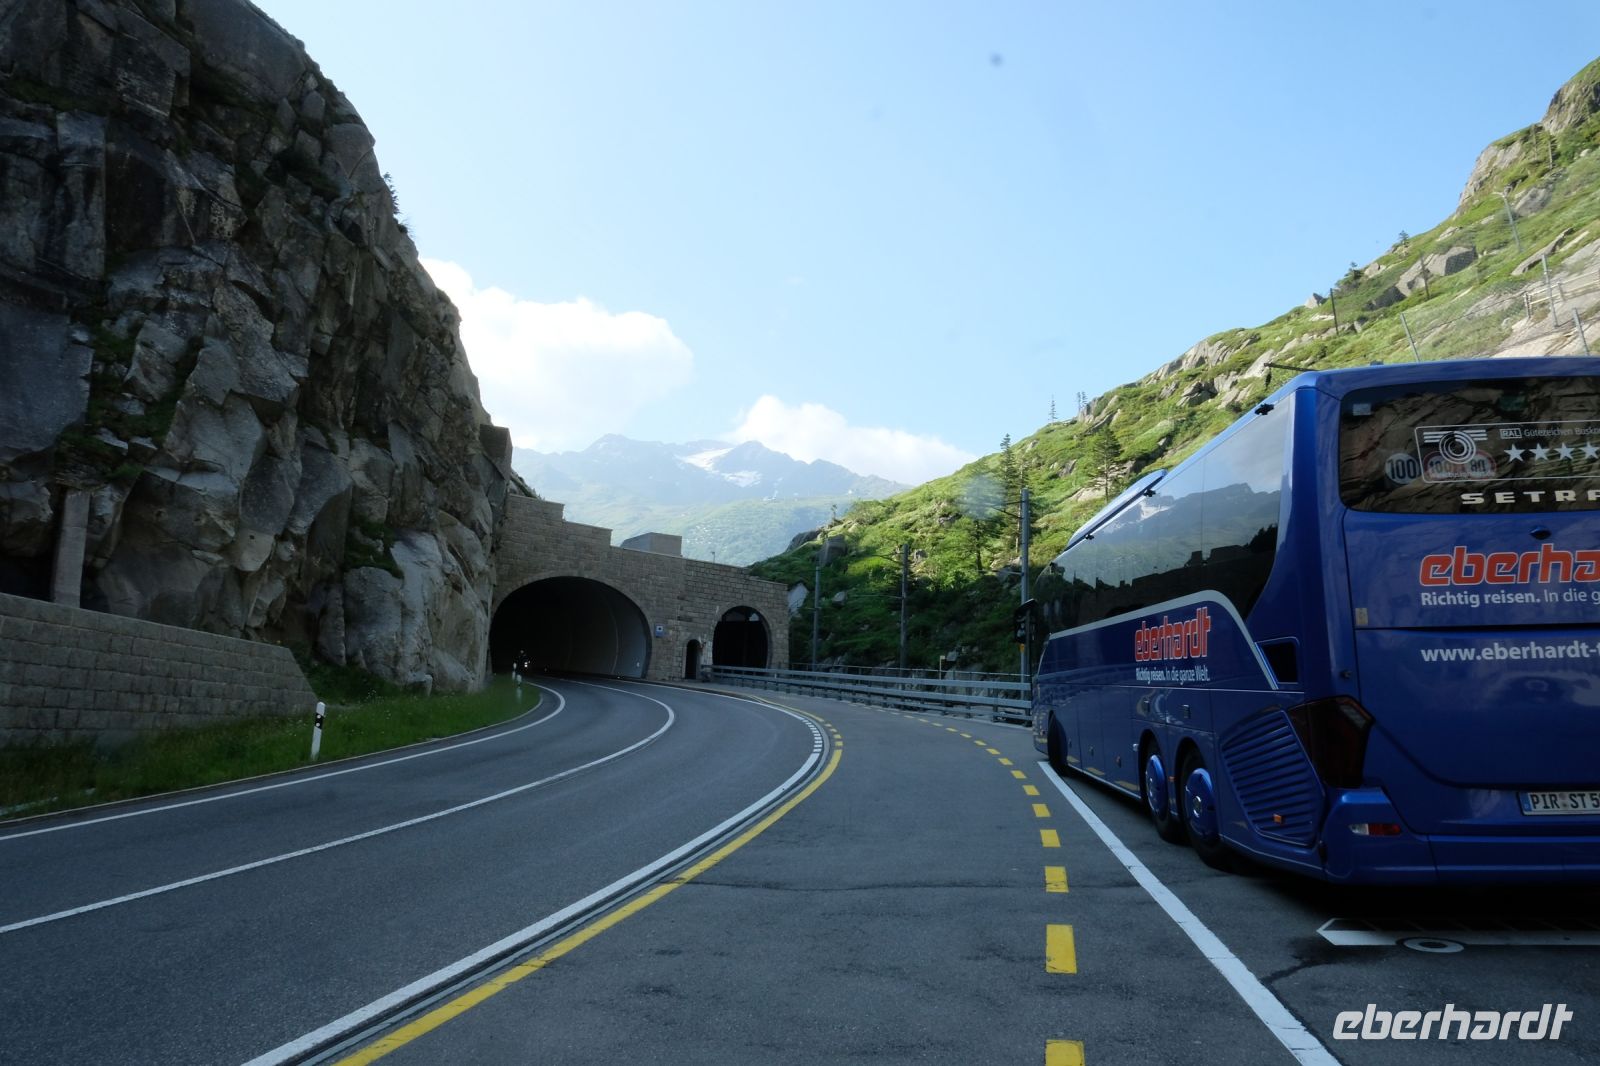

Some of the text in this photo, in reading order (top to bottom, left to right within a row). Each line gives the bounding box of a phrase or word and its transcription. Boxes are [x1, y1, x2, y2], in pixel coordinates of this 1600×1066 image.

[1502, 430, 1520, 438] RAL
[1387, 458, 1417, 480] 100
[1420, 591, 1480, 608] Richtig
[1484, 590, 1541, 605] reisen.
[1544, 589, 1559, 603] In
[1562, 588, 1588, 602] die
[1135, 607, 1211, 662] eberhardt
[1530, 794, 1560, 809] PIR
[1569, 793, 1587, 809] ST
